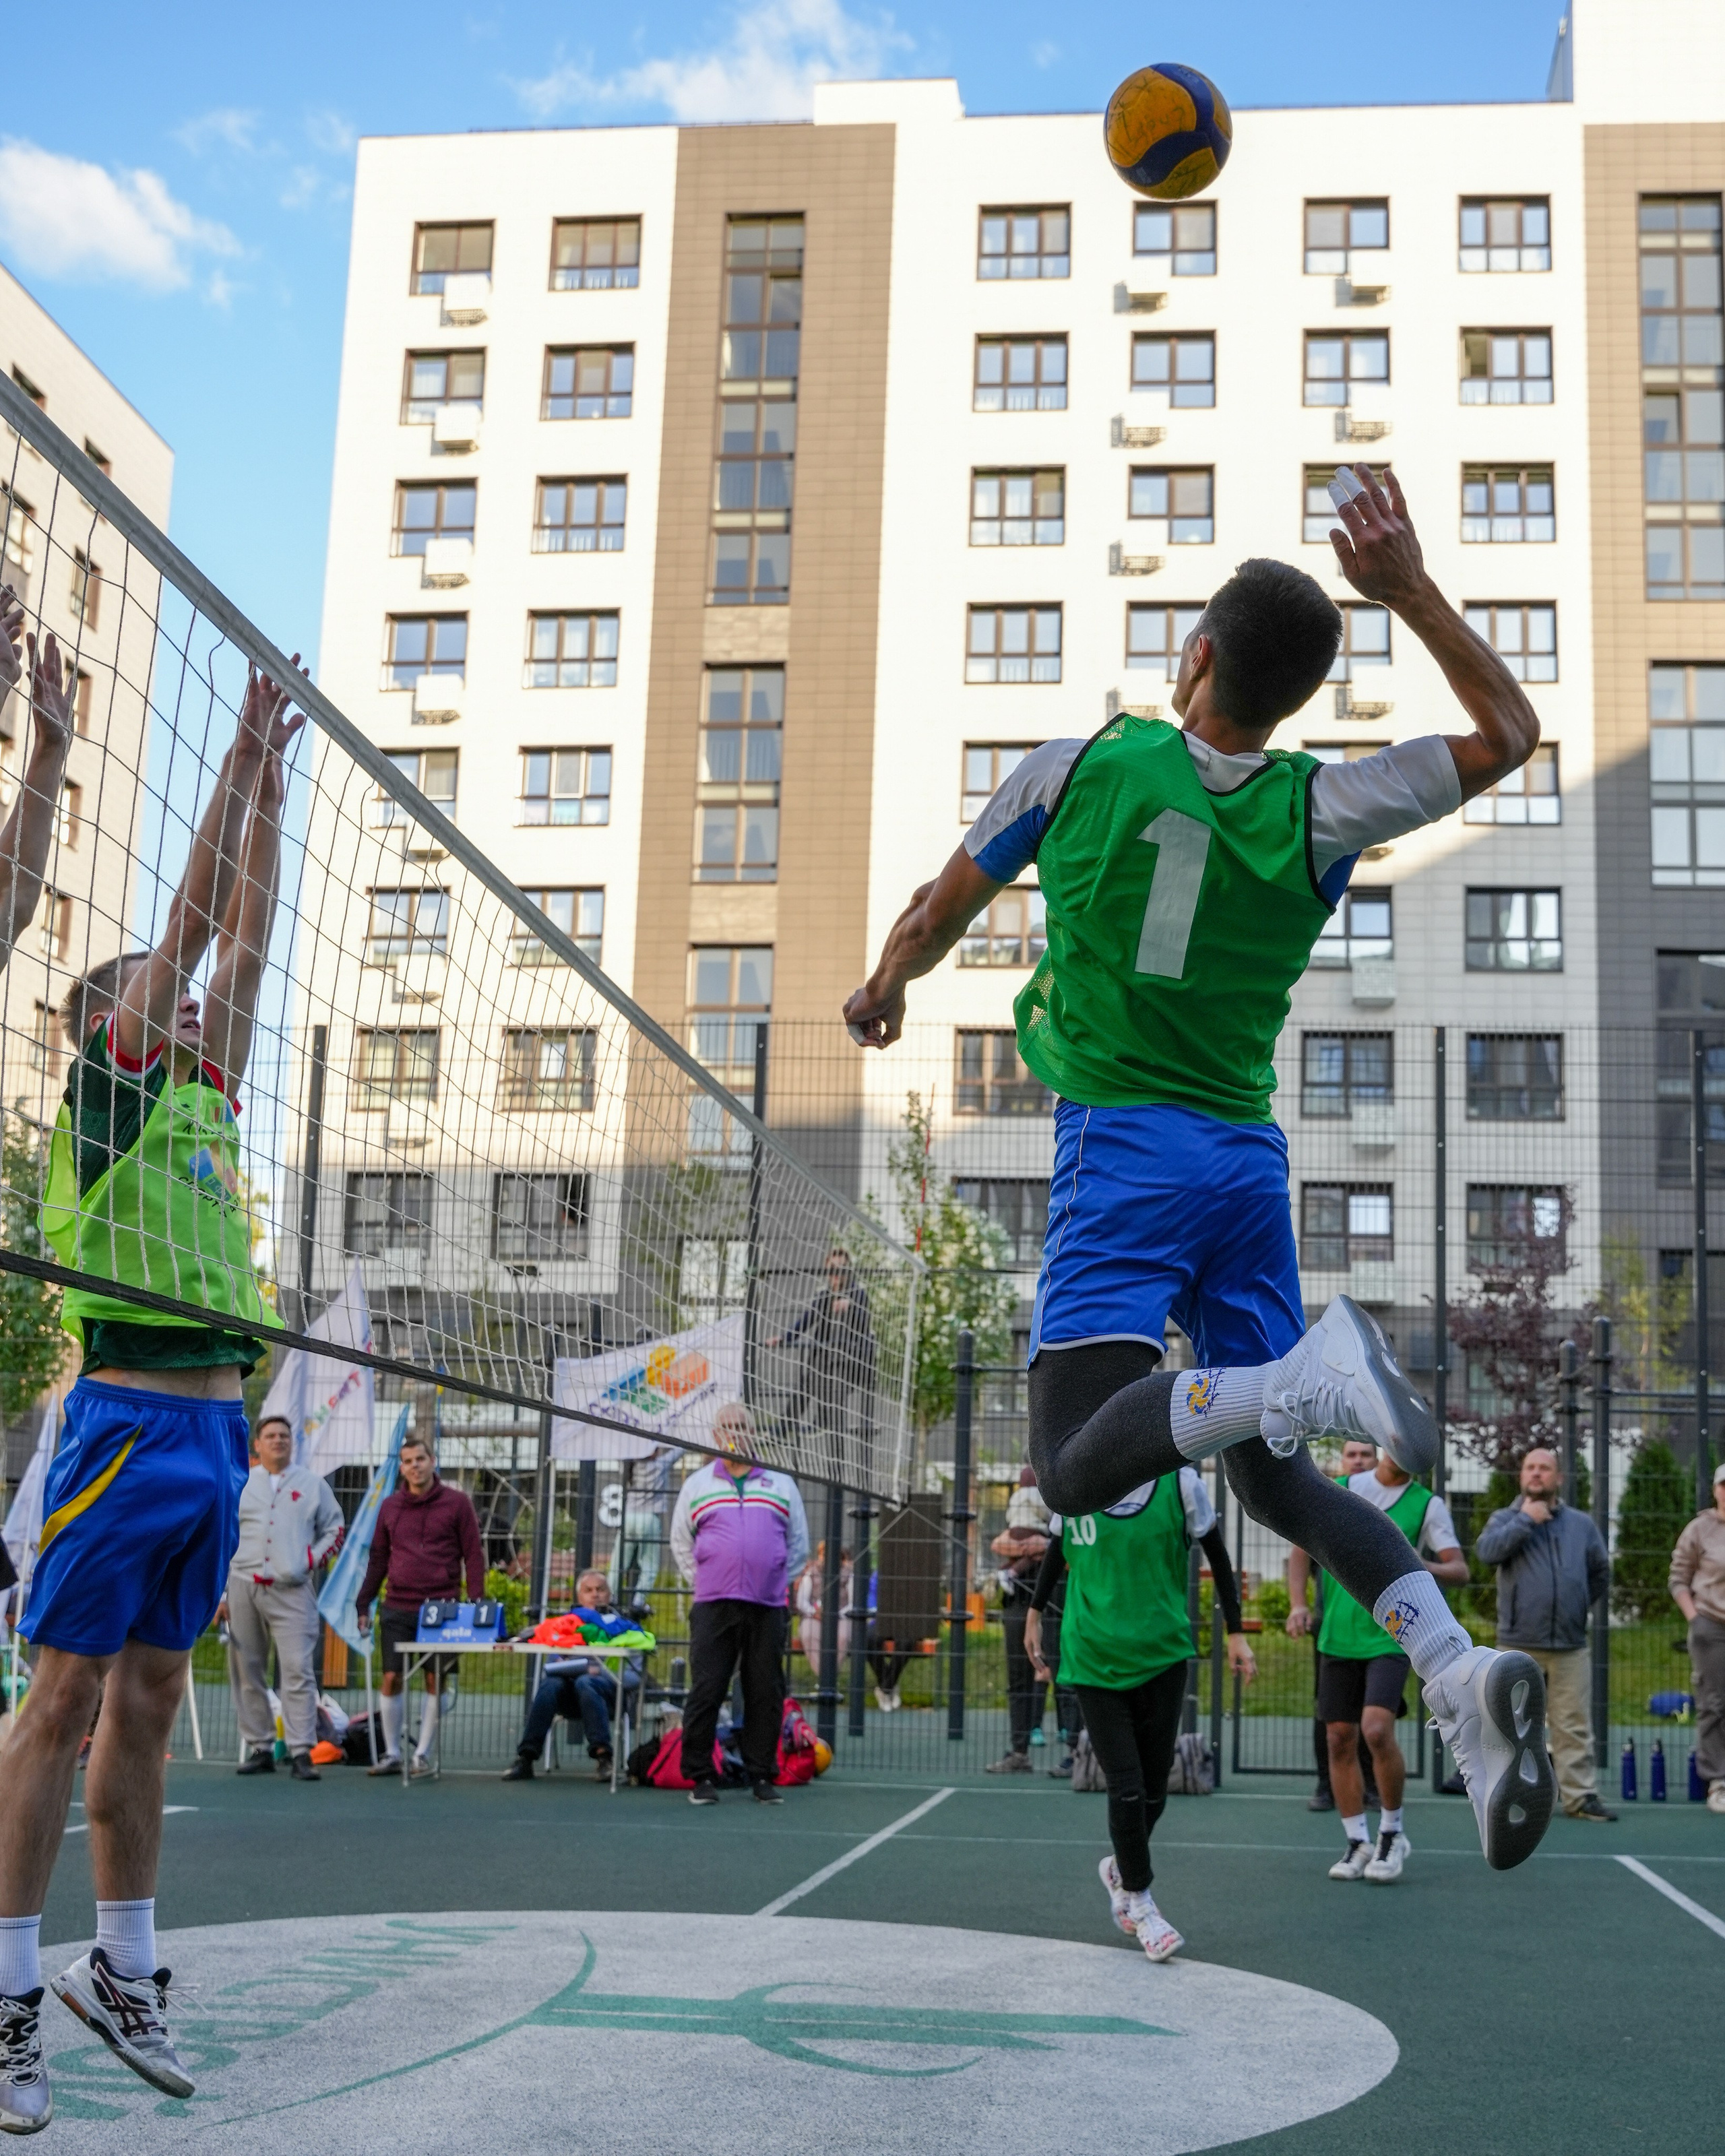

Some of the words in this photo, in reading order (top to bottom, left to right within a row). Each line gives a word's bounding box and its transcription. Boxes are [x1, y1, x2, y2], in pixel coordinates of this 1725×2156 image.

[1135, 808, 1212, 980] 1
[1066, 1514, 1096, 1546] 10
[425, 1605, 438, 1624] 3
[479, 1604, 489, 1624] 1
